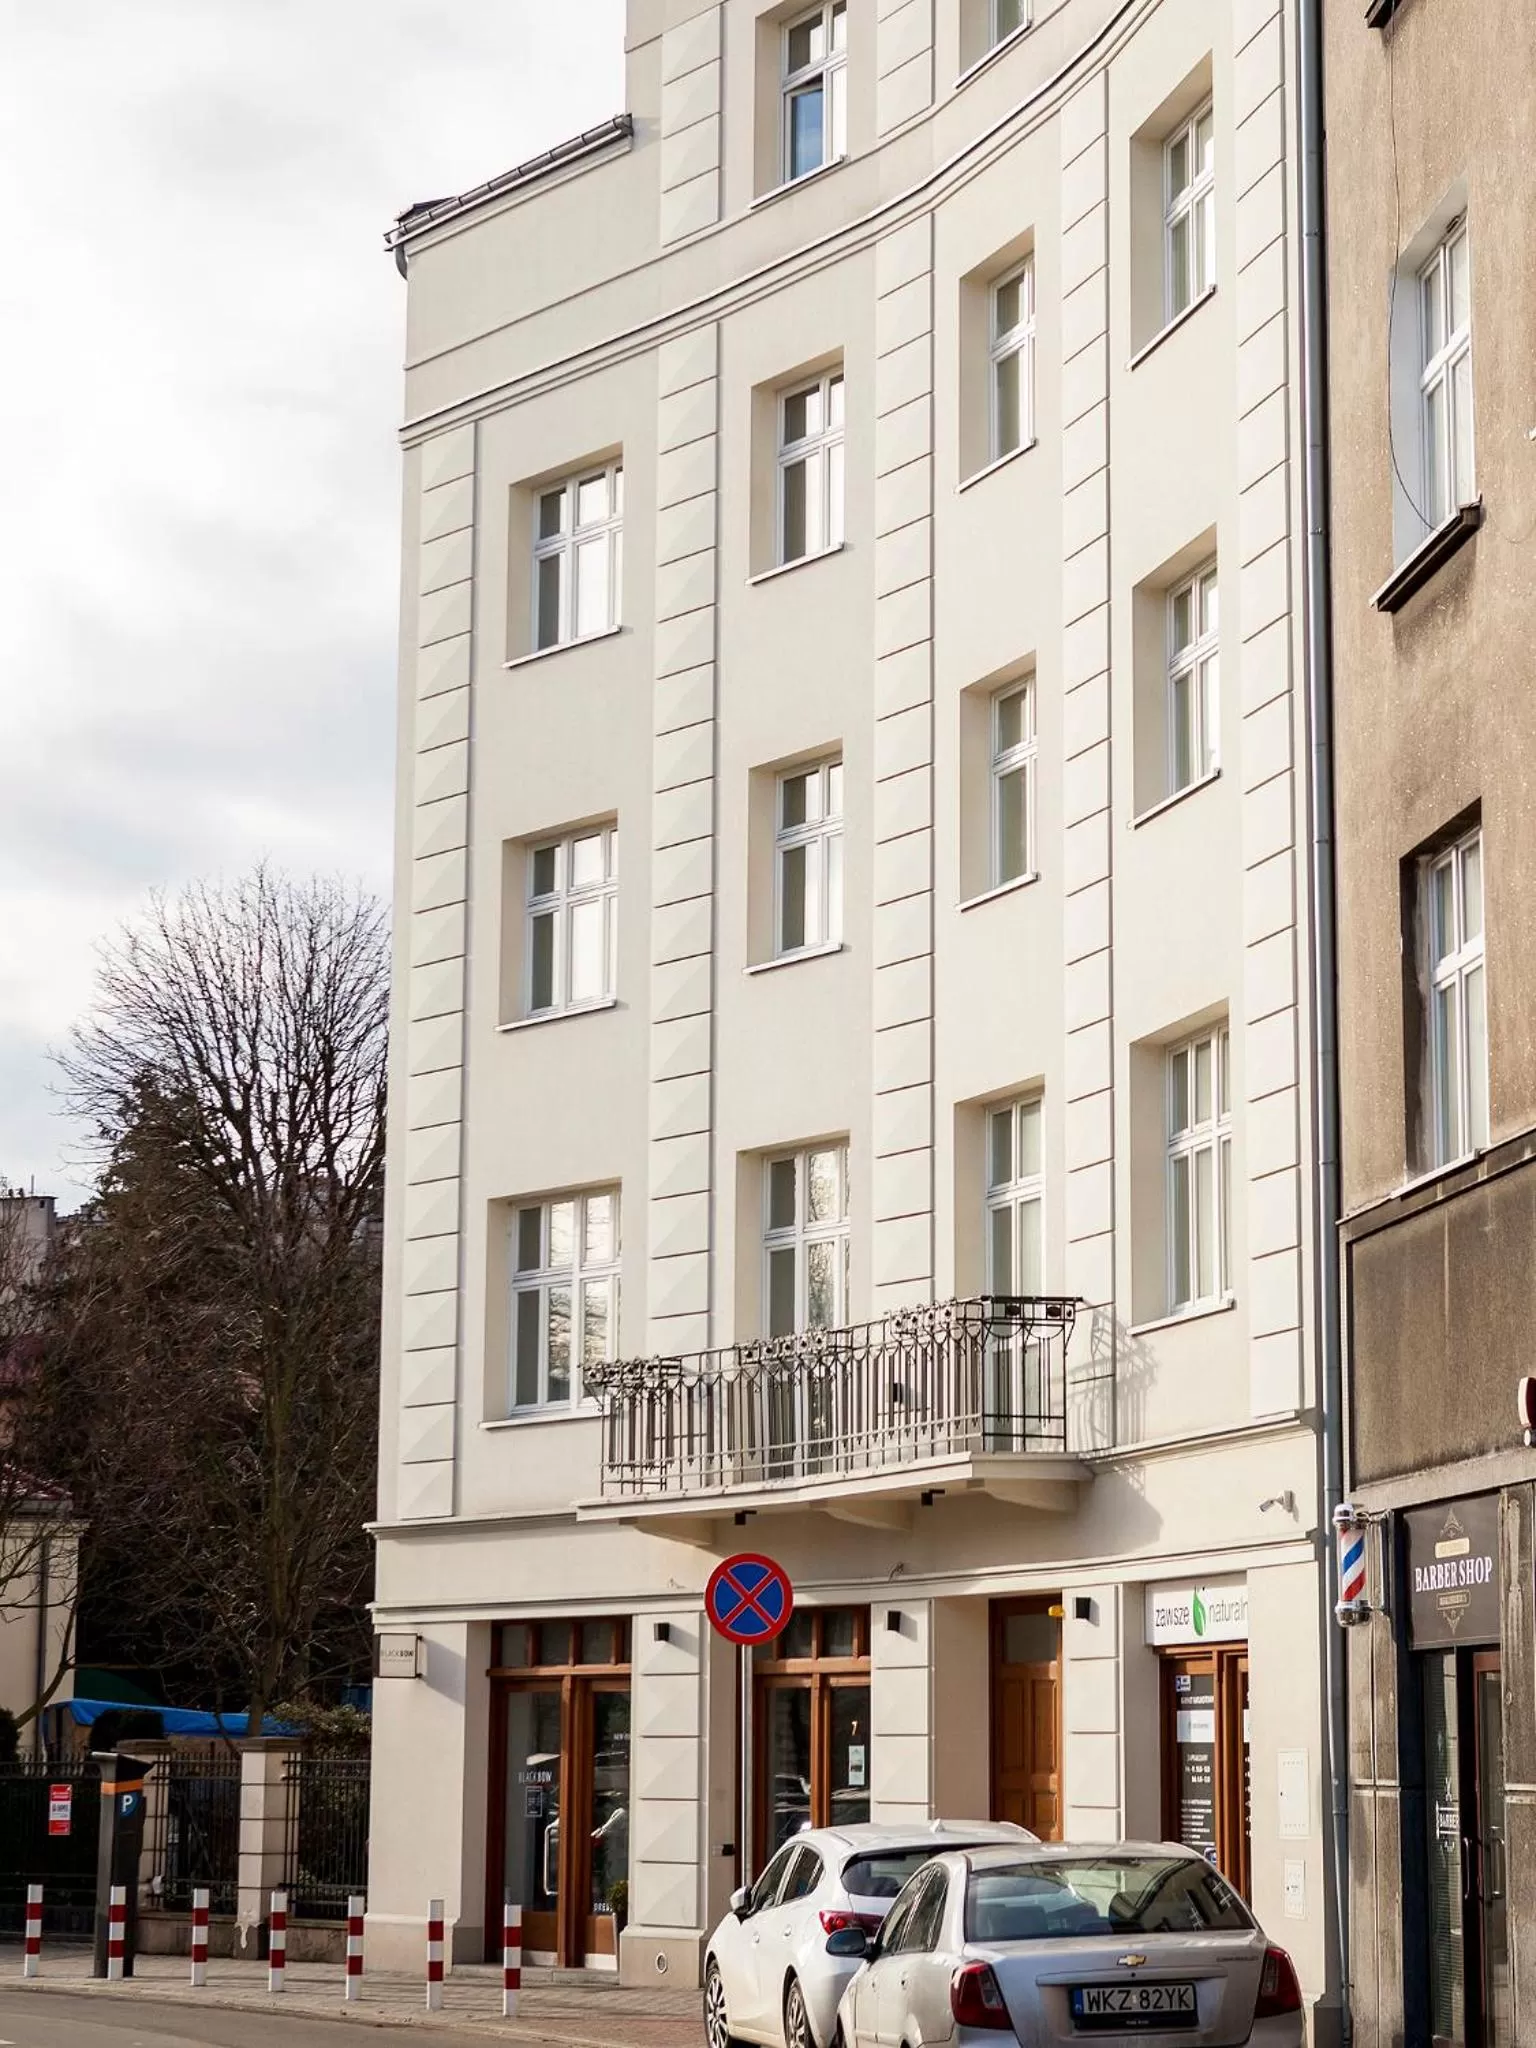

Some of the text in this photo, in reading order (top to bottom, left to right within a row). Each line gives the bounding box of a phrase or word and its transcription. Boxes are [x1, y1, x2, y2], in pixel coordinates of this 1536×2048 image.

[1415, 1556, 1493, 1593] BARBER SHOP
[1155, 1606, 1190, 1627] zawsze
[851, 1720, 858, 1737] 7
[122, 1794, 134, 1813] P
[1086, 1987, 1192, 2013] WKZ 82YK
